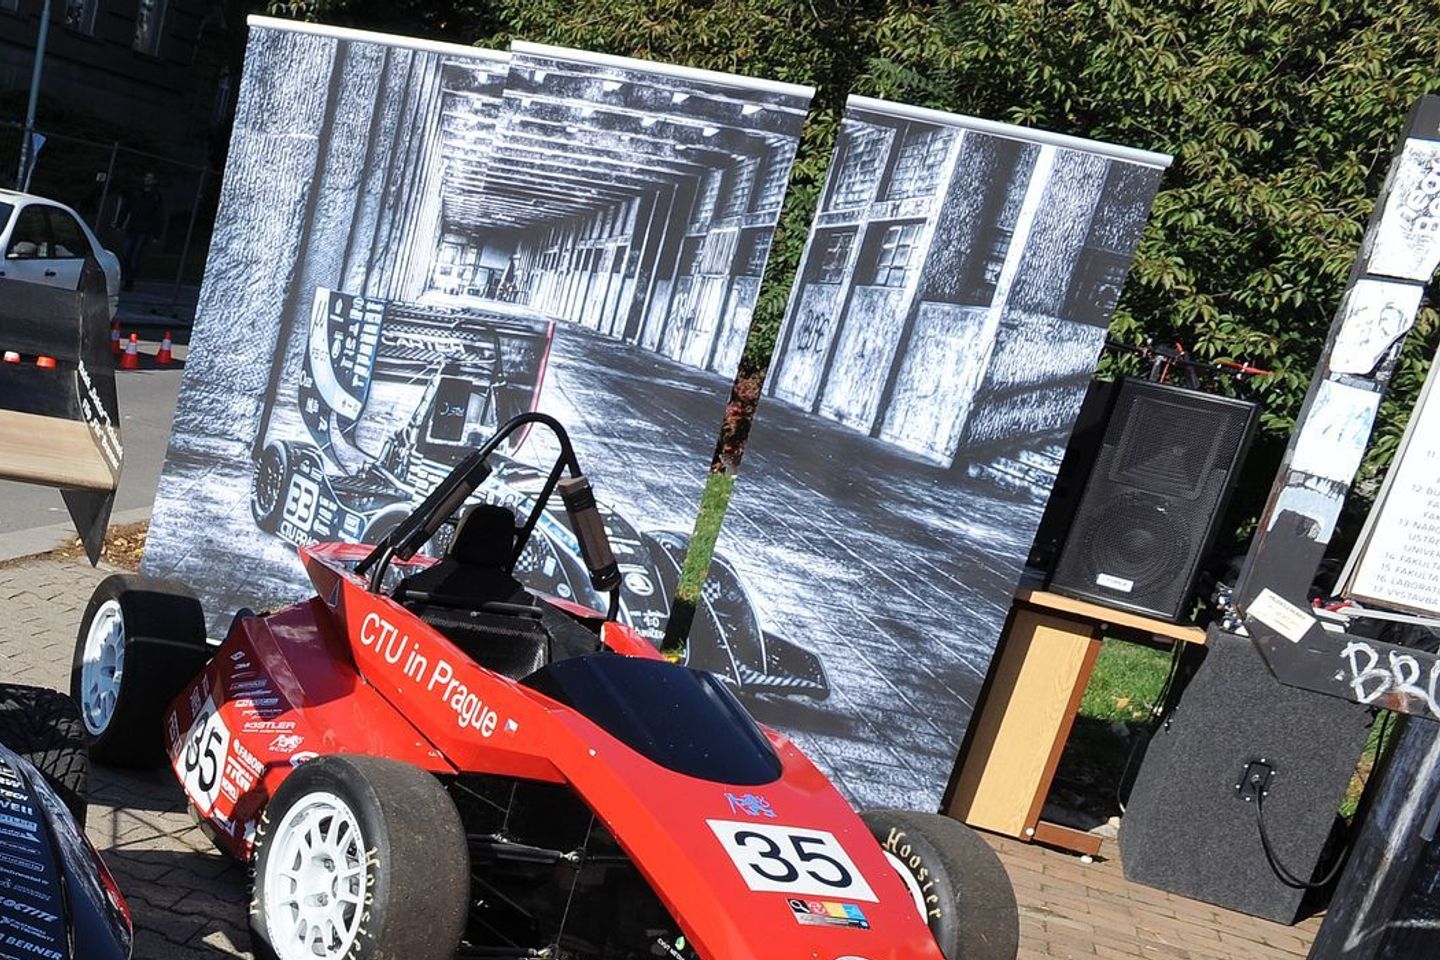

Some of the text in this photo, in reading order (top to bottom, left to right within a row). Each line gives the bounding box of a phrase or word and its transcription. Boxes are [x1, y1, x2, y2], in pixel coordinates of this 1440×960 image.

[285, 480, 314, 524] 33
[360, 612, 498, 738] CTU in Prague
[185, 711, 223, 793] 35
[244, 721, 297, 730] KISTLER
[732, 830, 853, 889] 35
[881, 827, 942, 919] Hoosier
[5, 936, 63, 960] BERNER
